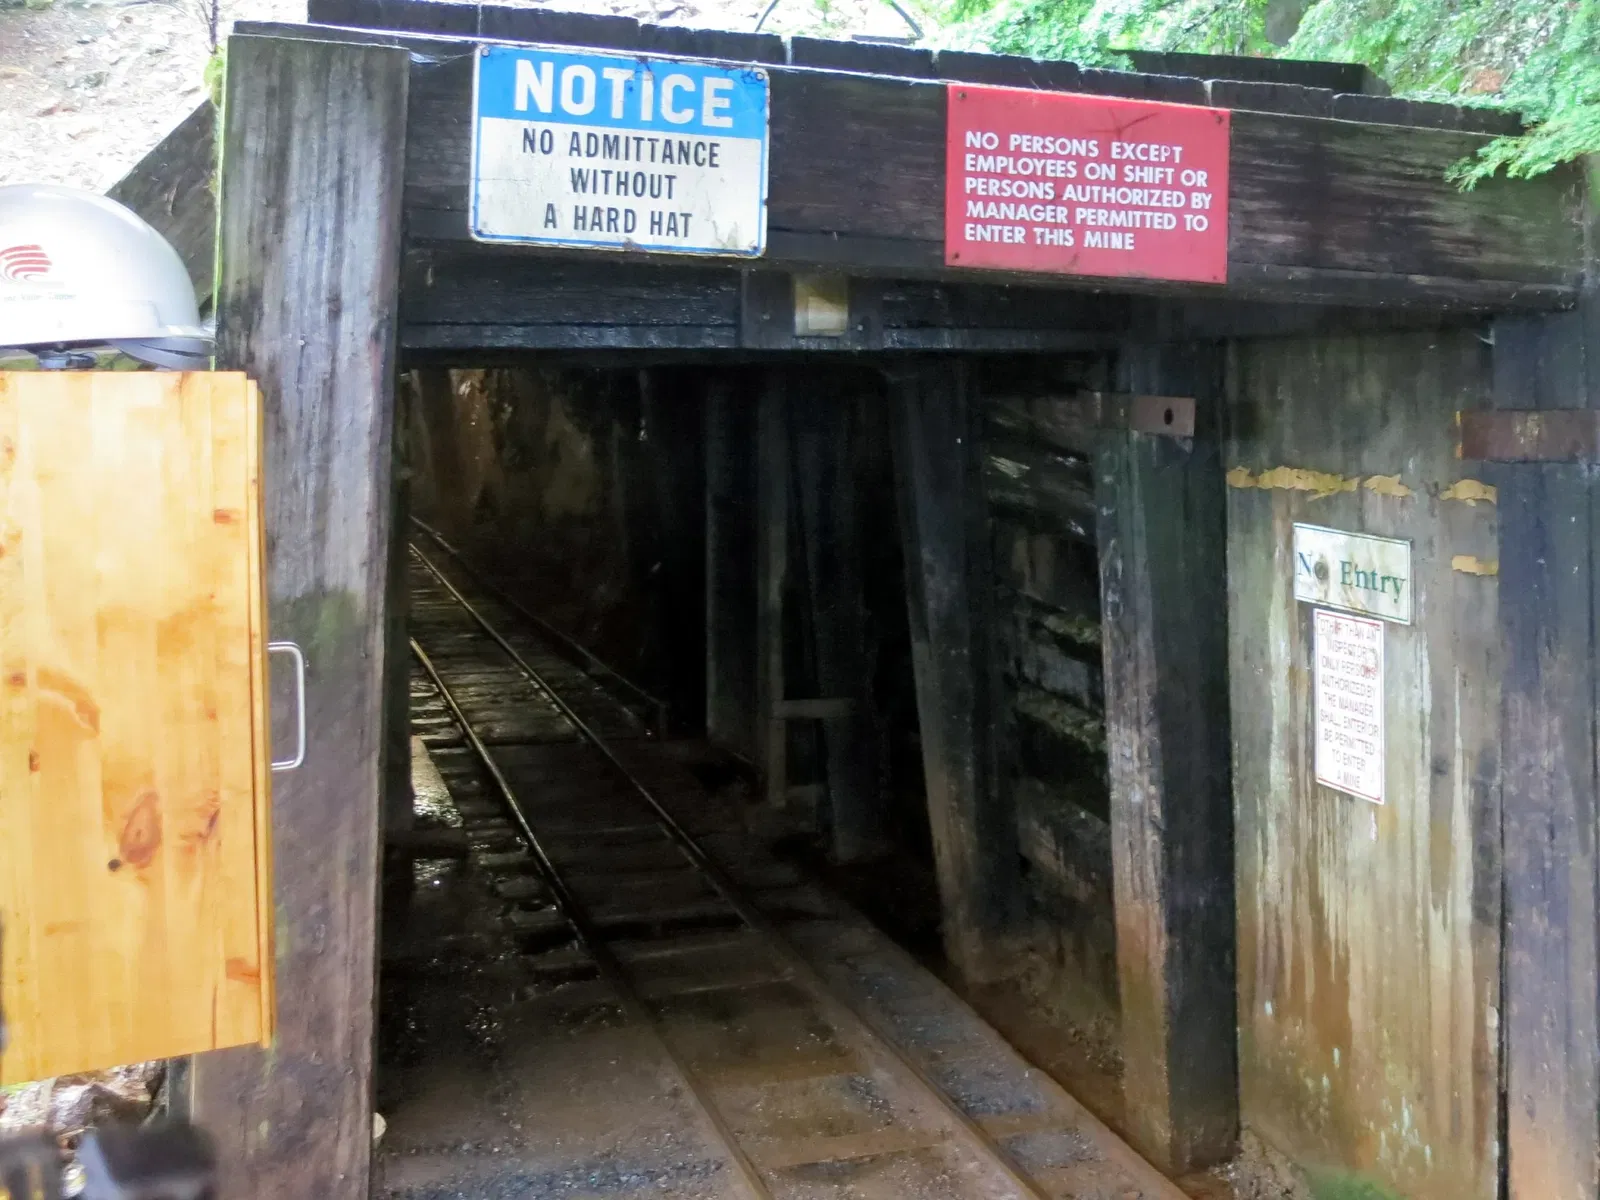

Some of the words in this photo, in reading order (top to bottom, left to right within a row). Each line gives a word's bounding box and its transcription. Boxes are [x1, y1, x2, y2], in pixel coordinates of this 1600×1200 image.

[514, 59, 734, 128] NOTICE
[522, 128, 554, 155] NO
[569, 131, 721, 168] ADMITTANCE
[965, 131, 999, 150] NO
[1009, 134, 1099, 158] PERSONS
[1111, 142, 1183, 163] EXCEPT
[570, 167, 677, 200] WITHOUT
[965, 154, 1077, 178] EMPLOYEES
[1084, 162, 1116, 181] ON
[1123, 164, 1175, 185] SHIFT
[1180, 169, 1208, 188] OR
[965, 177, 1055, 200] PERSONS
[1062, 185, 1186, 208] AUTHORIZED
[1190, 191, 1212, 210] BY
[544, 203, 557, 229] A
[574, 205, 637, 235] HARD
[649, 211, 693, 238] HAT
[965, 200, 1068, 224] MANAGER
[1075, 208, 1177, 230] PERMITTED
[1183, 214, 1208, 232] TO
[965, 223, 1026, 244] ENTER
[1033, 227, 1075, 247] THIS
[1083, 230, 1135, 250] MINE
[1340, 559, 1406, 604] Entry
[1322, 674, 1366, 697] AUTHORIZED
[1320, 708, 1341, 727] SHALL
[1343, 715, 1366, 734] ENTER
[1324, 692, 1336, 708] THE
[1339, 696, 1373, 718] MANAGER
[1324, 728, 1333, 743] BE
[1335, 731, 1375, 755] PERMITTED
[1343, 752, 1365, 772] ENTER
